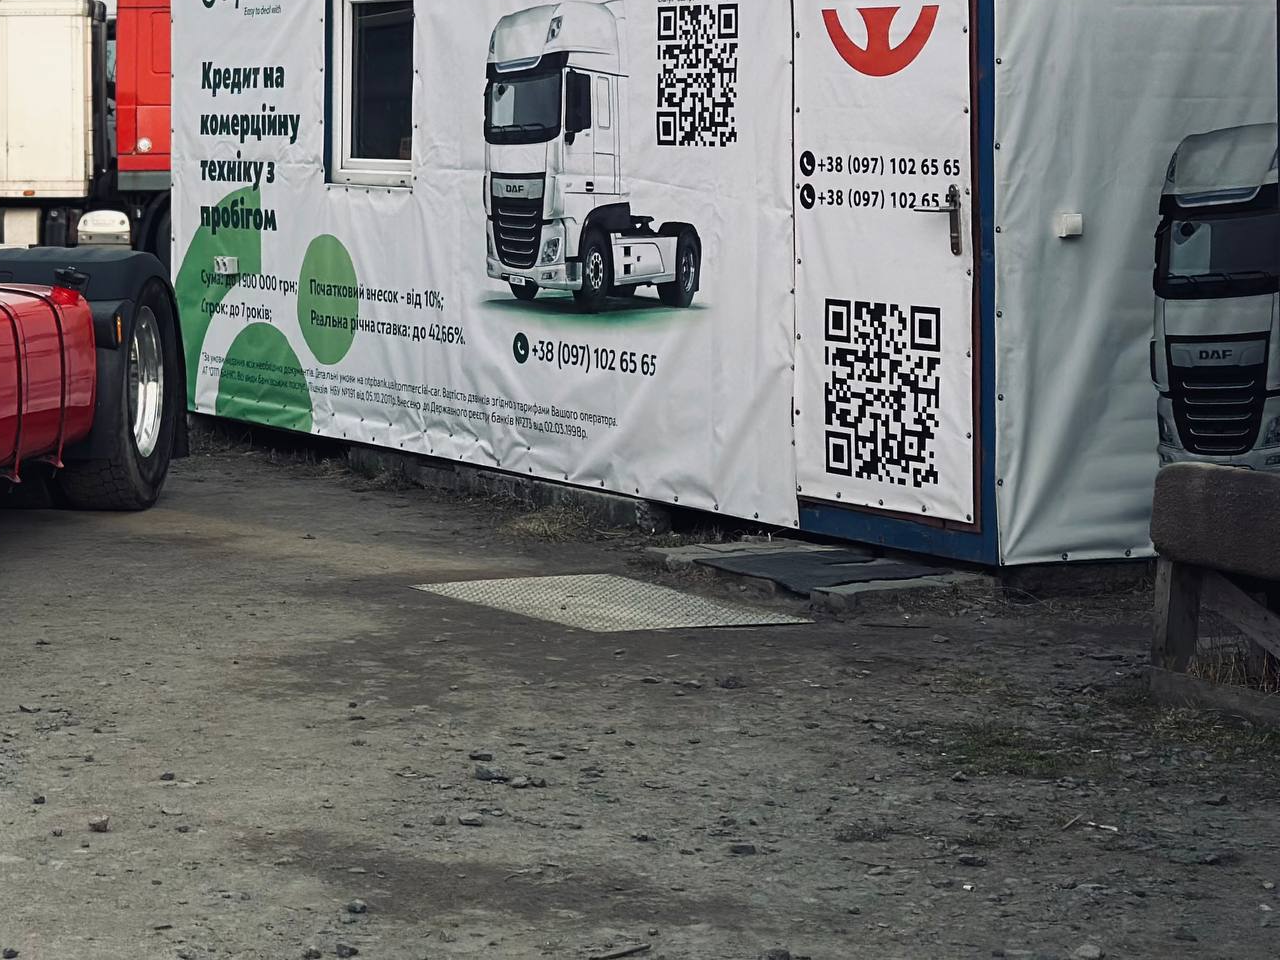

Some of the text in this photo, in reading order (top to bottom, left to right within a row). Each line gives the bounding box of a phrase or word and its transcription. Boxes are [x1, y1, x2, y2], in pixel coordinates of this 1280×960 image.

[201, 61, 284, 97] Кредит на
[200, 102, 300, 144] комерційну
[200, 150, 275, 191] техніку з
[818, 155, 961, 176] +38 (097) 102 65 65
[505, 184, 524, 193] DAF
[818, 190, 844, 206] +38
[848, 189, 885, 209] (097)
[890, 192, 917, 209] 102
[921, 193, 940, 207] 65
[200, 196, 277, 235] пробігом
[242, 273, 257, 289] 900
[259, 274, 277, 291] 000
[279, 280, 298, 296] грн;
[310, 279, 365, 300] Початковий
[366, 289, 399, 303] внесок
[407, 288, 422, 309] від
[229, 304, 240, 318] до
[310, 310, 348, 330] Реальна
[350, 314, 376, 334] річна
[376, 320, 411, 338] ставка:
[412, 326, 426, 342] до
[532, 341, 657, 376] +38 (097) 102 65 65
[1199, 349, 1233, 360] DAF
[551, 405, 578, 420] Вашого
